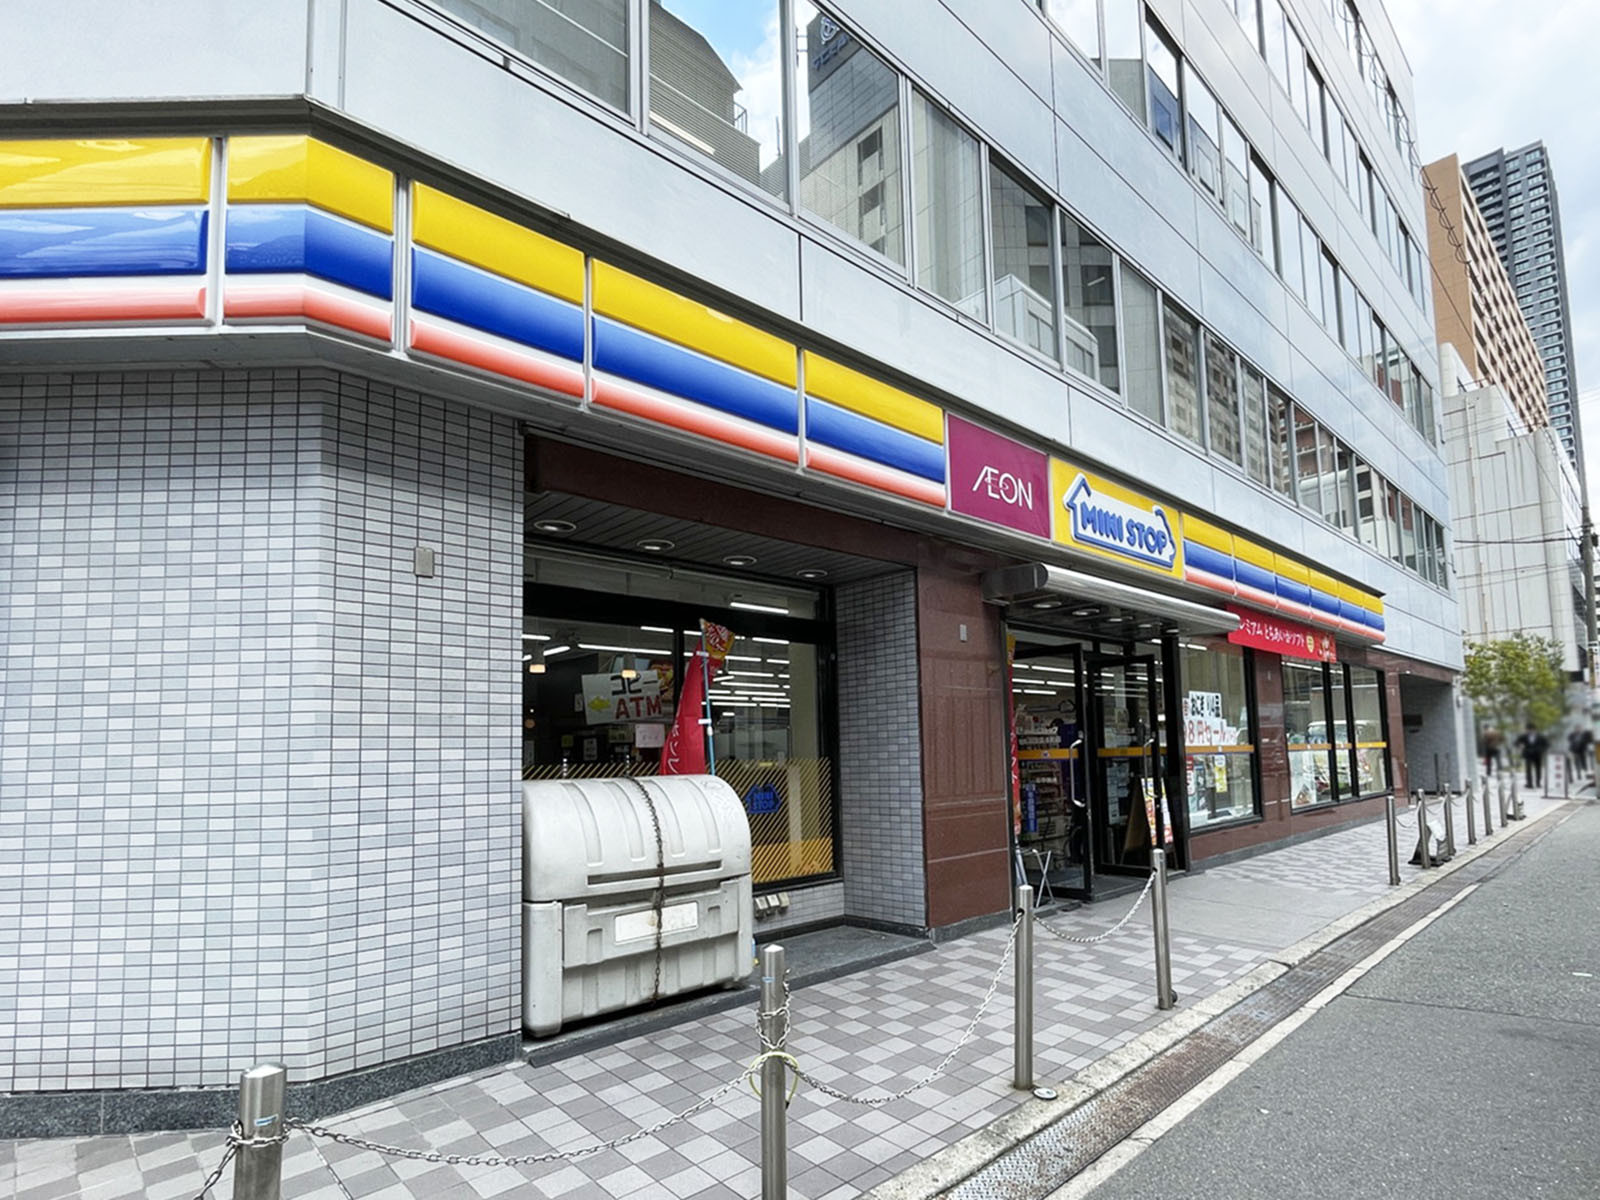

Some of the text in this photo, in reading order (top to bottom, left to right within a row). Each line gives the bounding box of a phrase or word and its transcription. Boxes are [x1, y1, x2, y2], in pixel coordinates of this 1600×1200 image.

[1081, 501, 1167, 555] MINI STOP
[610, 672, 658, 696] コピー
[615, 695, 662, 719] ATM
